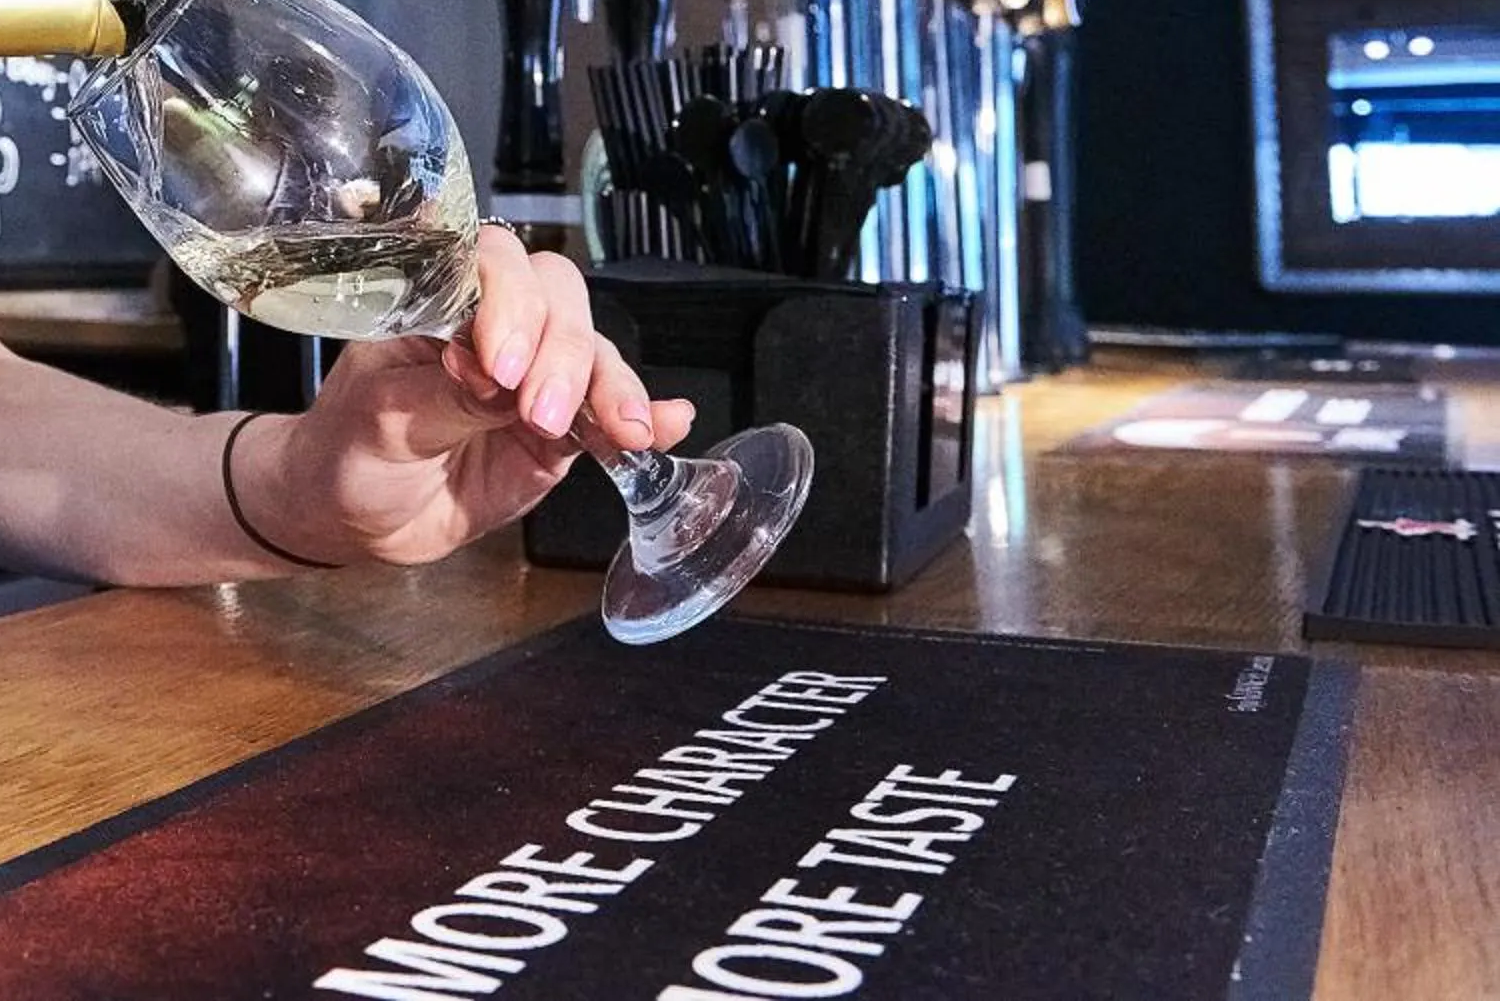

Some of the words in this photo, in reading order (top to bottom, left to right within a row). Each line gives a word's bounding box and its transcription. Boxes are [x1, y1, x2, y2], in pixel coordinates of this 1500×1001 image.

[313, 843, 655, 1001] MORE
[565, 671, 888, 842] CHARACTER
[656, 878, 924, 1001] ORE
[797, 764, 1018, 875] TASTE
